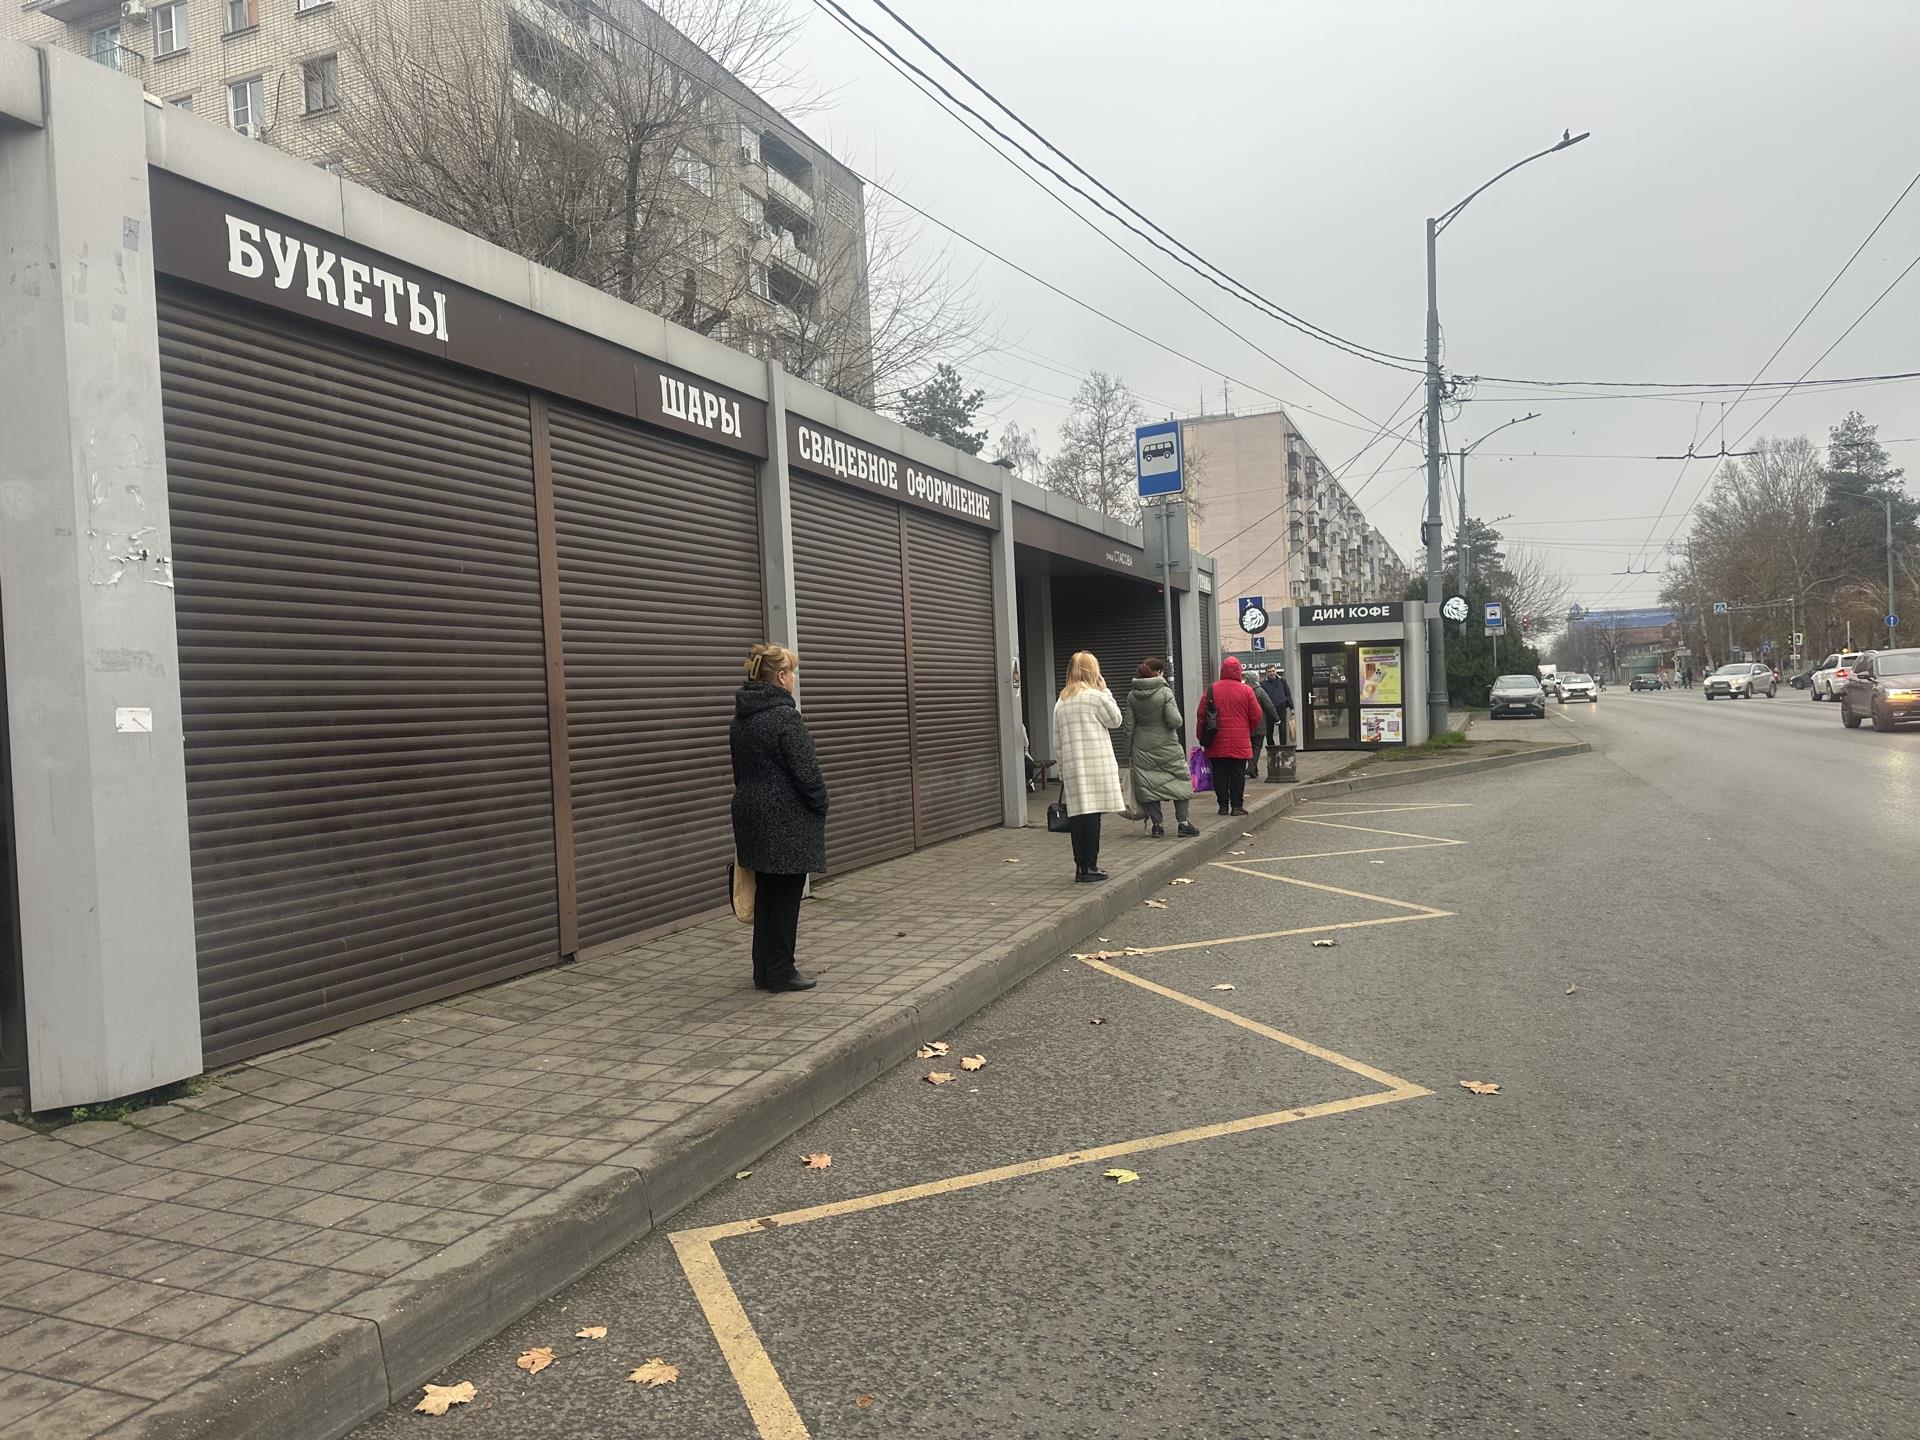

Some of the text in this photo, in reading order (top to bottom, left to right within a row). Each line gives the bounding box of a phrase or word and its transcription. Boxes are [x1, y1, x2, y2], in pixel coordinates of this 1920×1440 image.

[225, 214, 449, 342] БУКЕТЫ
[659, 374, 742, 438] ШАРЫ
[798, 426, 991, 520] СВАДЕБНОЕ ОФОРМЛЕНИЕ
[1312, 605, 1390, 621] ДИМ КОФЕ
